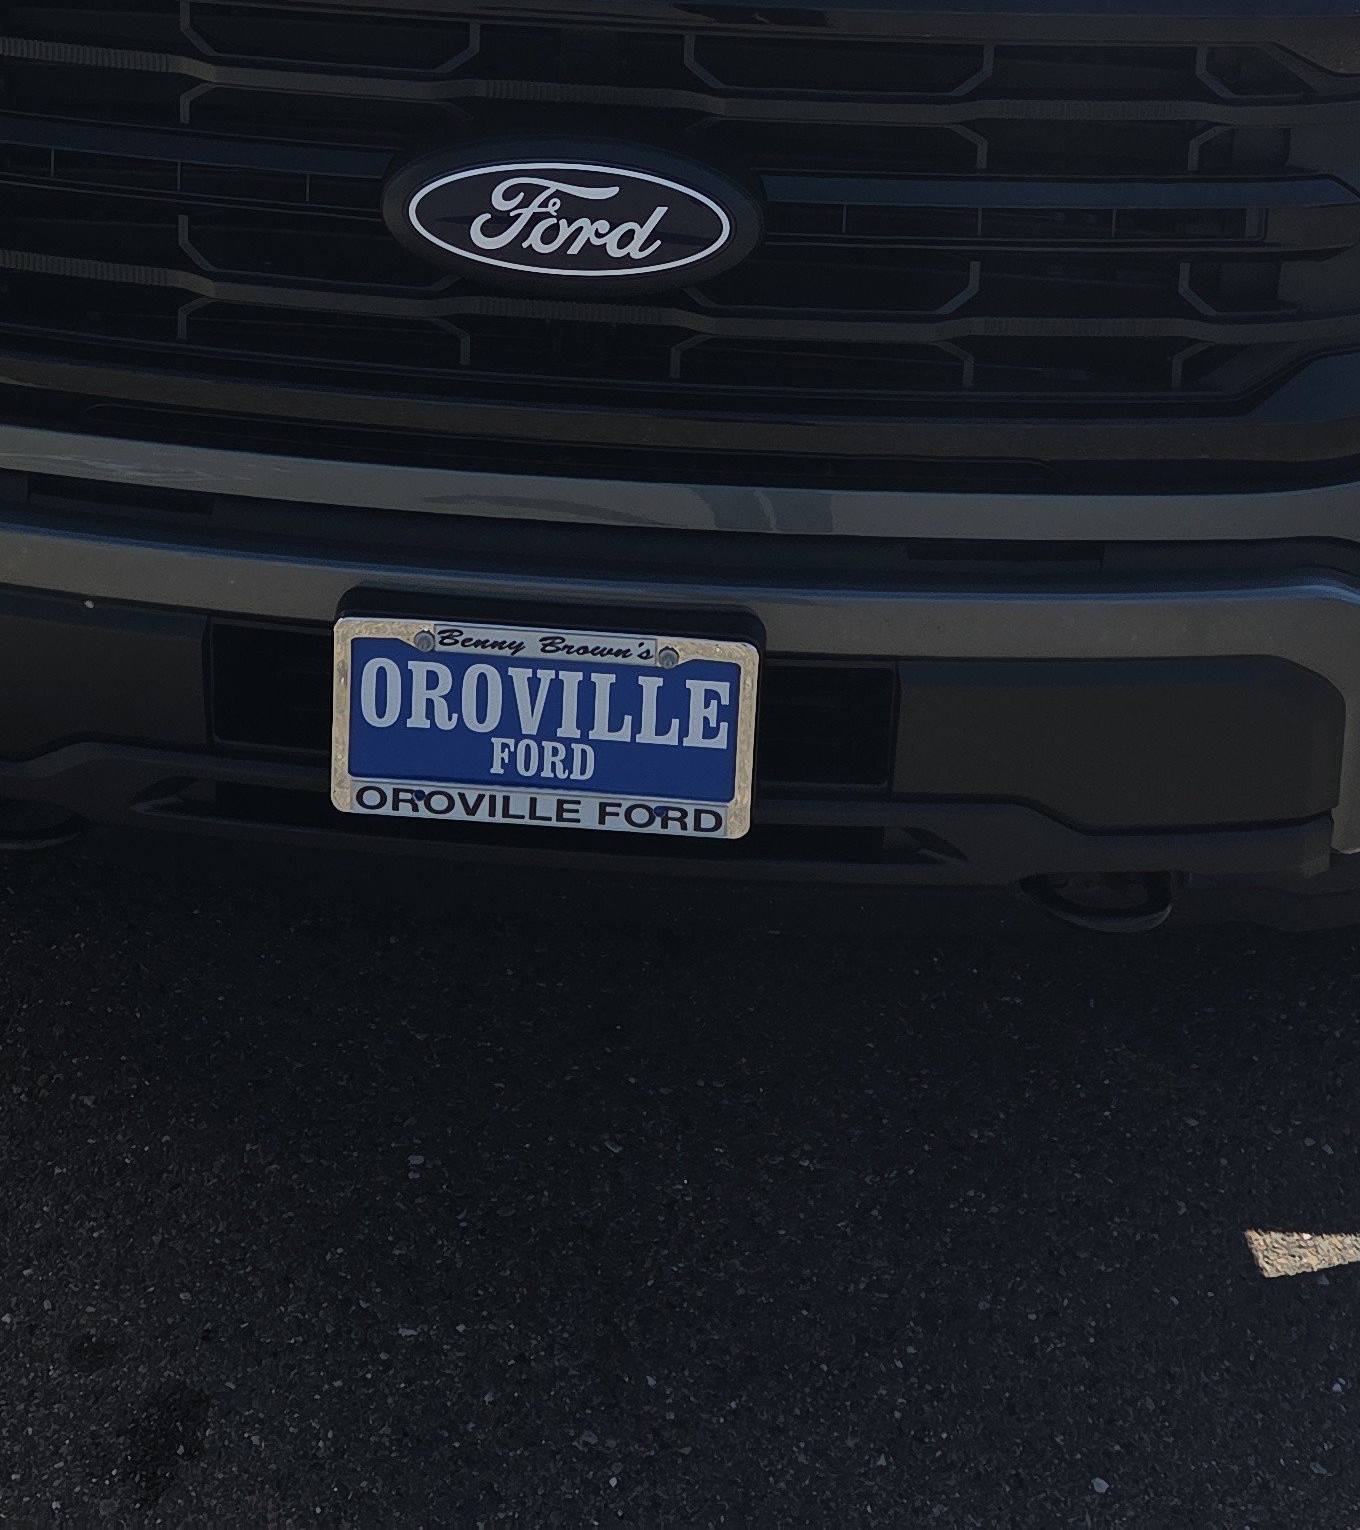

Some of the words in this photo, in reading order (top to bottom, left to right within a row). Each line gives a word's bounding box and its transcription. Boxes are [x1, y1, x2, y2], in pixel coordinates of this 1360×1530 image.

[470, 177, 668, 259] Ford
[437, 628, 526, 656] Benny
[539, 635, 654, 660] Brown's
[360, 657, 730, 750] OROVILLE
[490, 737, 595, 781] FORD
[355, 785, 581, 824] OROVILLE
[598, 801, 723, 833] FORD
